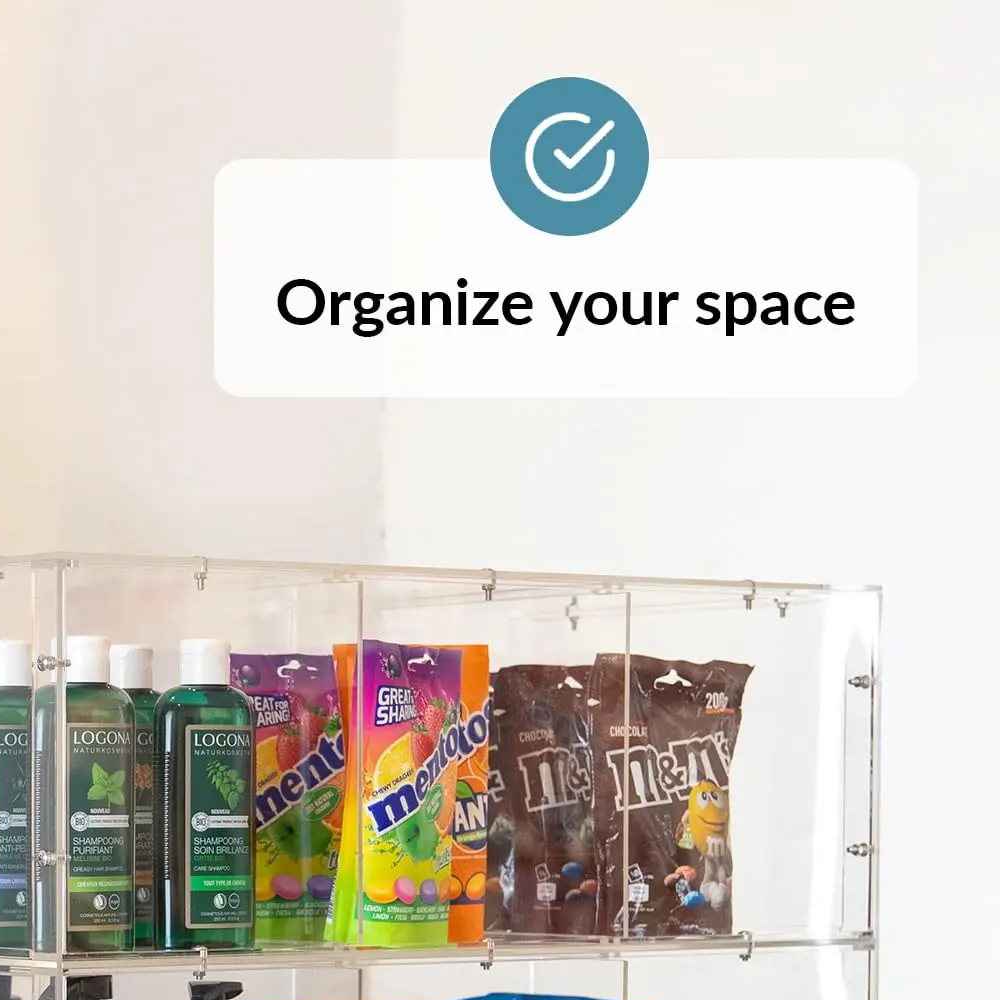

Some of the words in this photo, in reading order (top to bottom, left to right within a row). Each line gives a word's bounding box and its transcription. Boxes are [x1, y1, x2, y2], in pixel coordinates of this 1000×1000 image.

[378, 687, 411, 706] GREAT
[275, 701, 289, 710] FOR
[73, 731, 131, 745] LOGONA
[194, 733, 250, 747] LOGONA
[372, 783, 392, 797] CHEWY
[73, 847, 113, 855] PURIFIANT
[193, 846, 215, 855] SOIN
[216, 846, 249, 854] BRILLANCE
